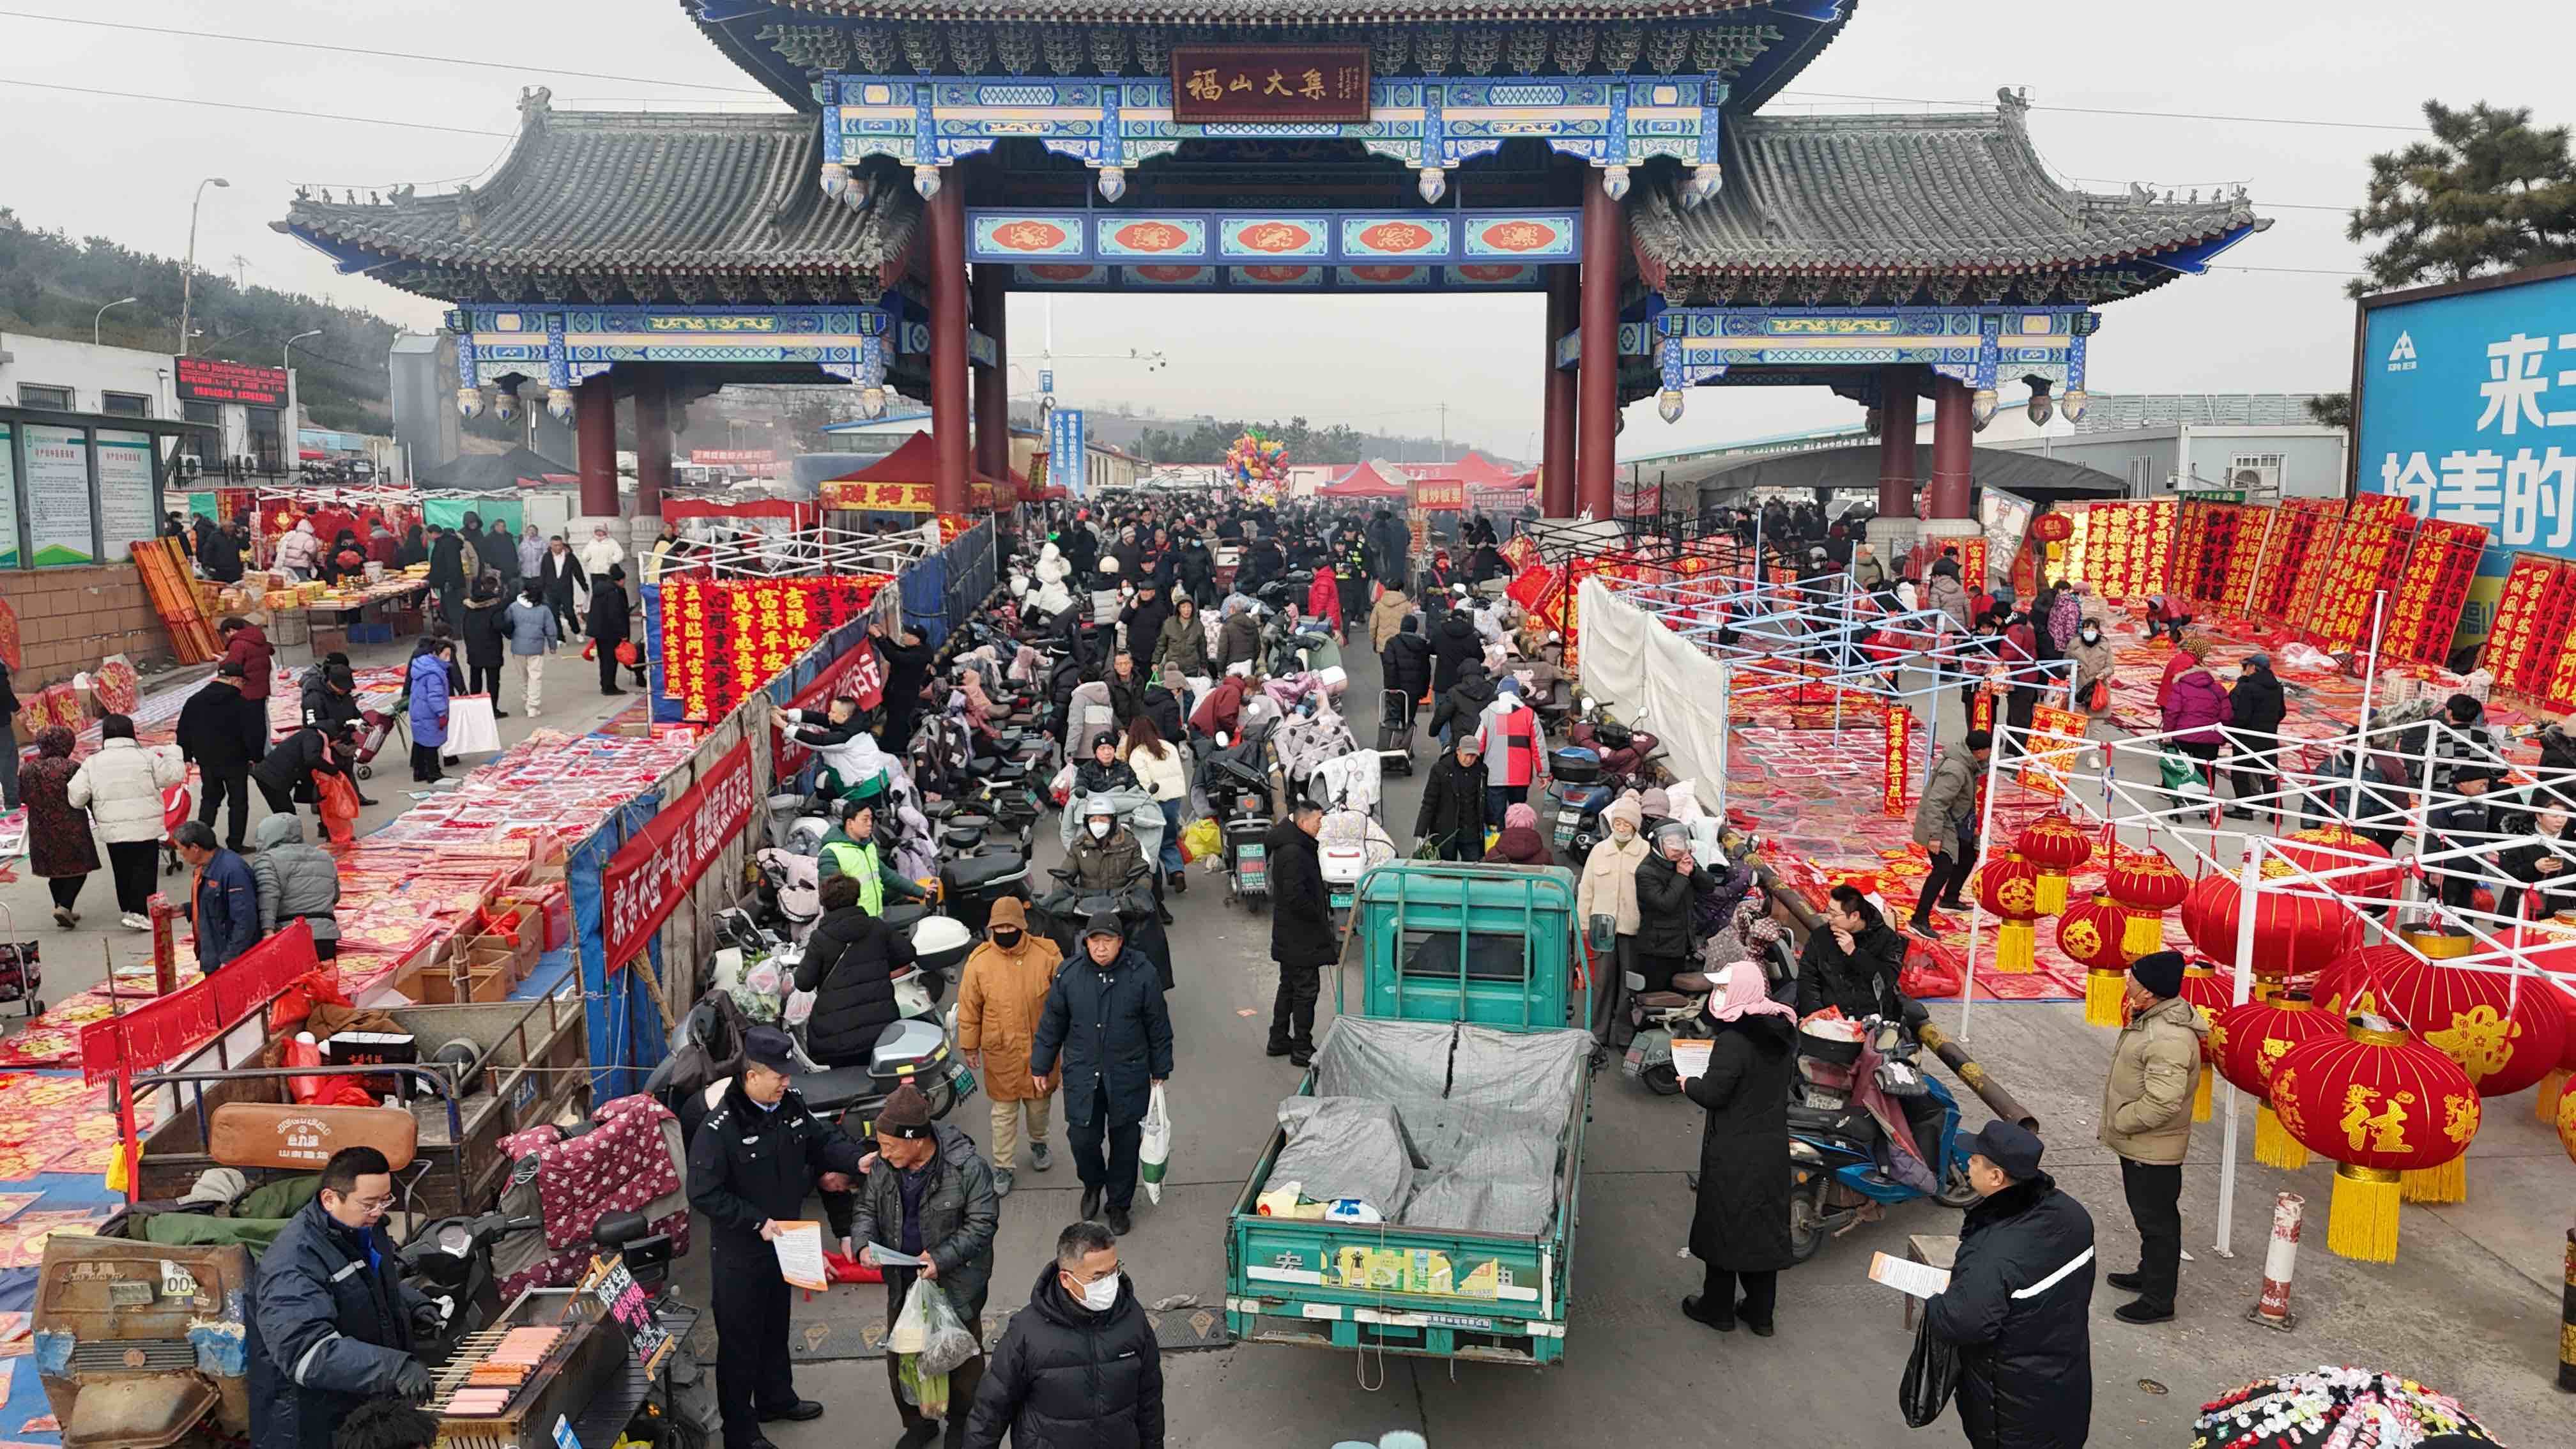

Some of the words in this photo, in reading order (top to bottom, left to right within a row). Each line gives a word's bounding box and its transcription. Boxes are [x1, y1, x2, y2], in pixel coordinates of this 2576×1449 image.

[1186, 68, 1327, 100] 福山大集
[754, 588, 788, 677] 富貴平安
[905, 1129, 914, 1139] K
